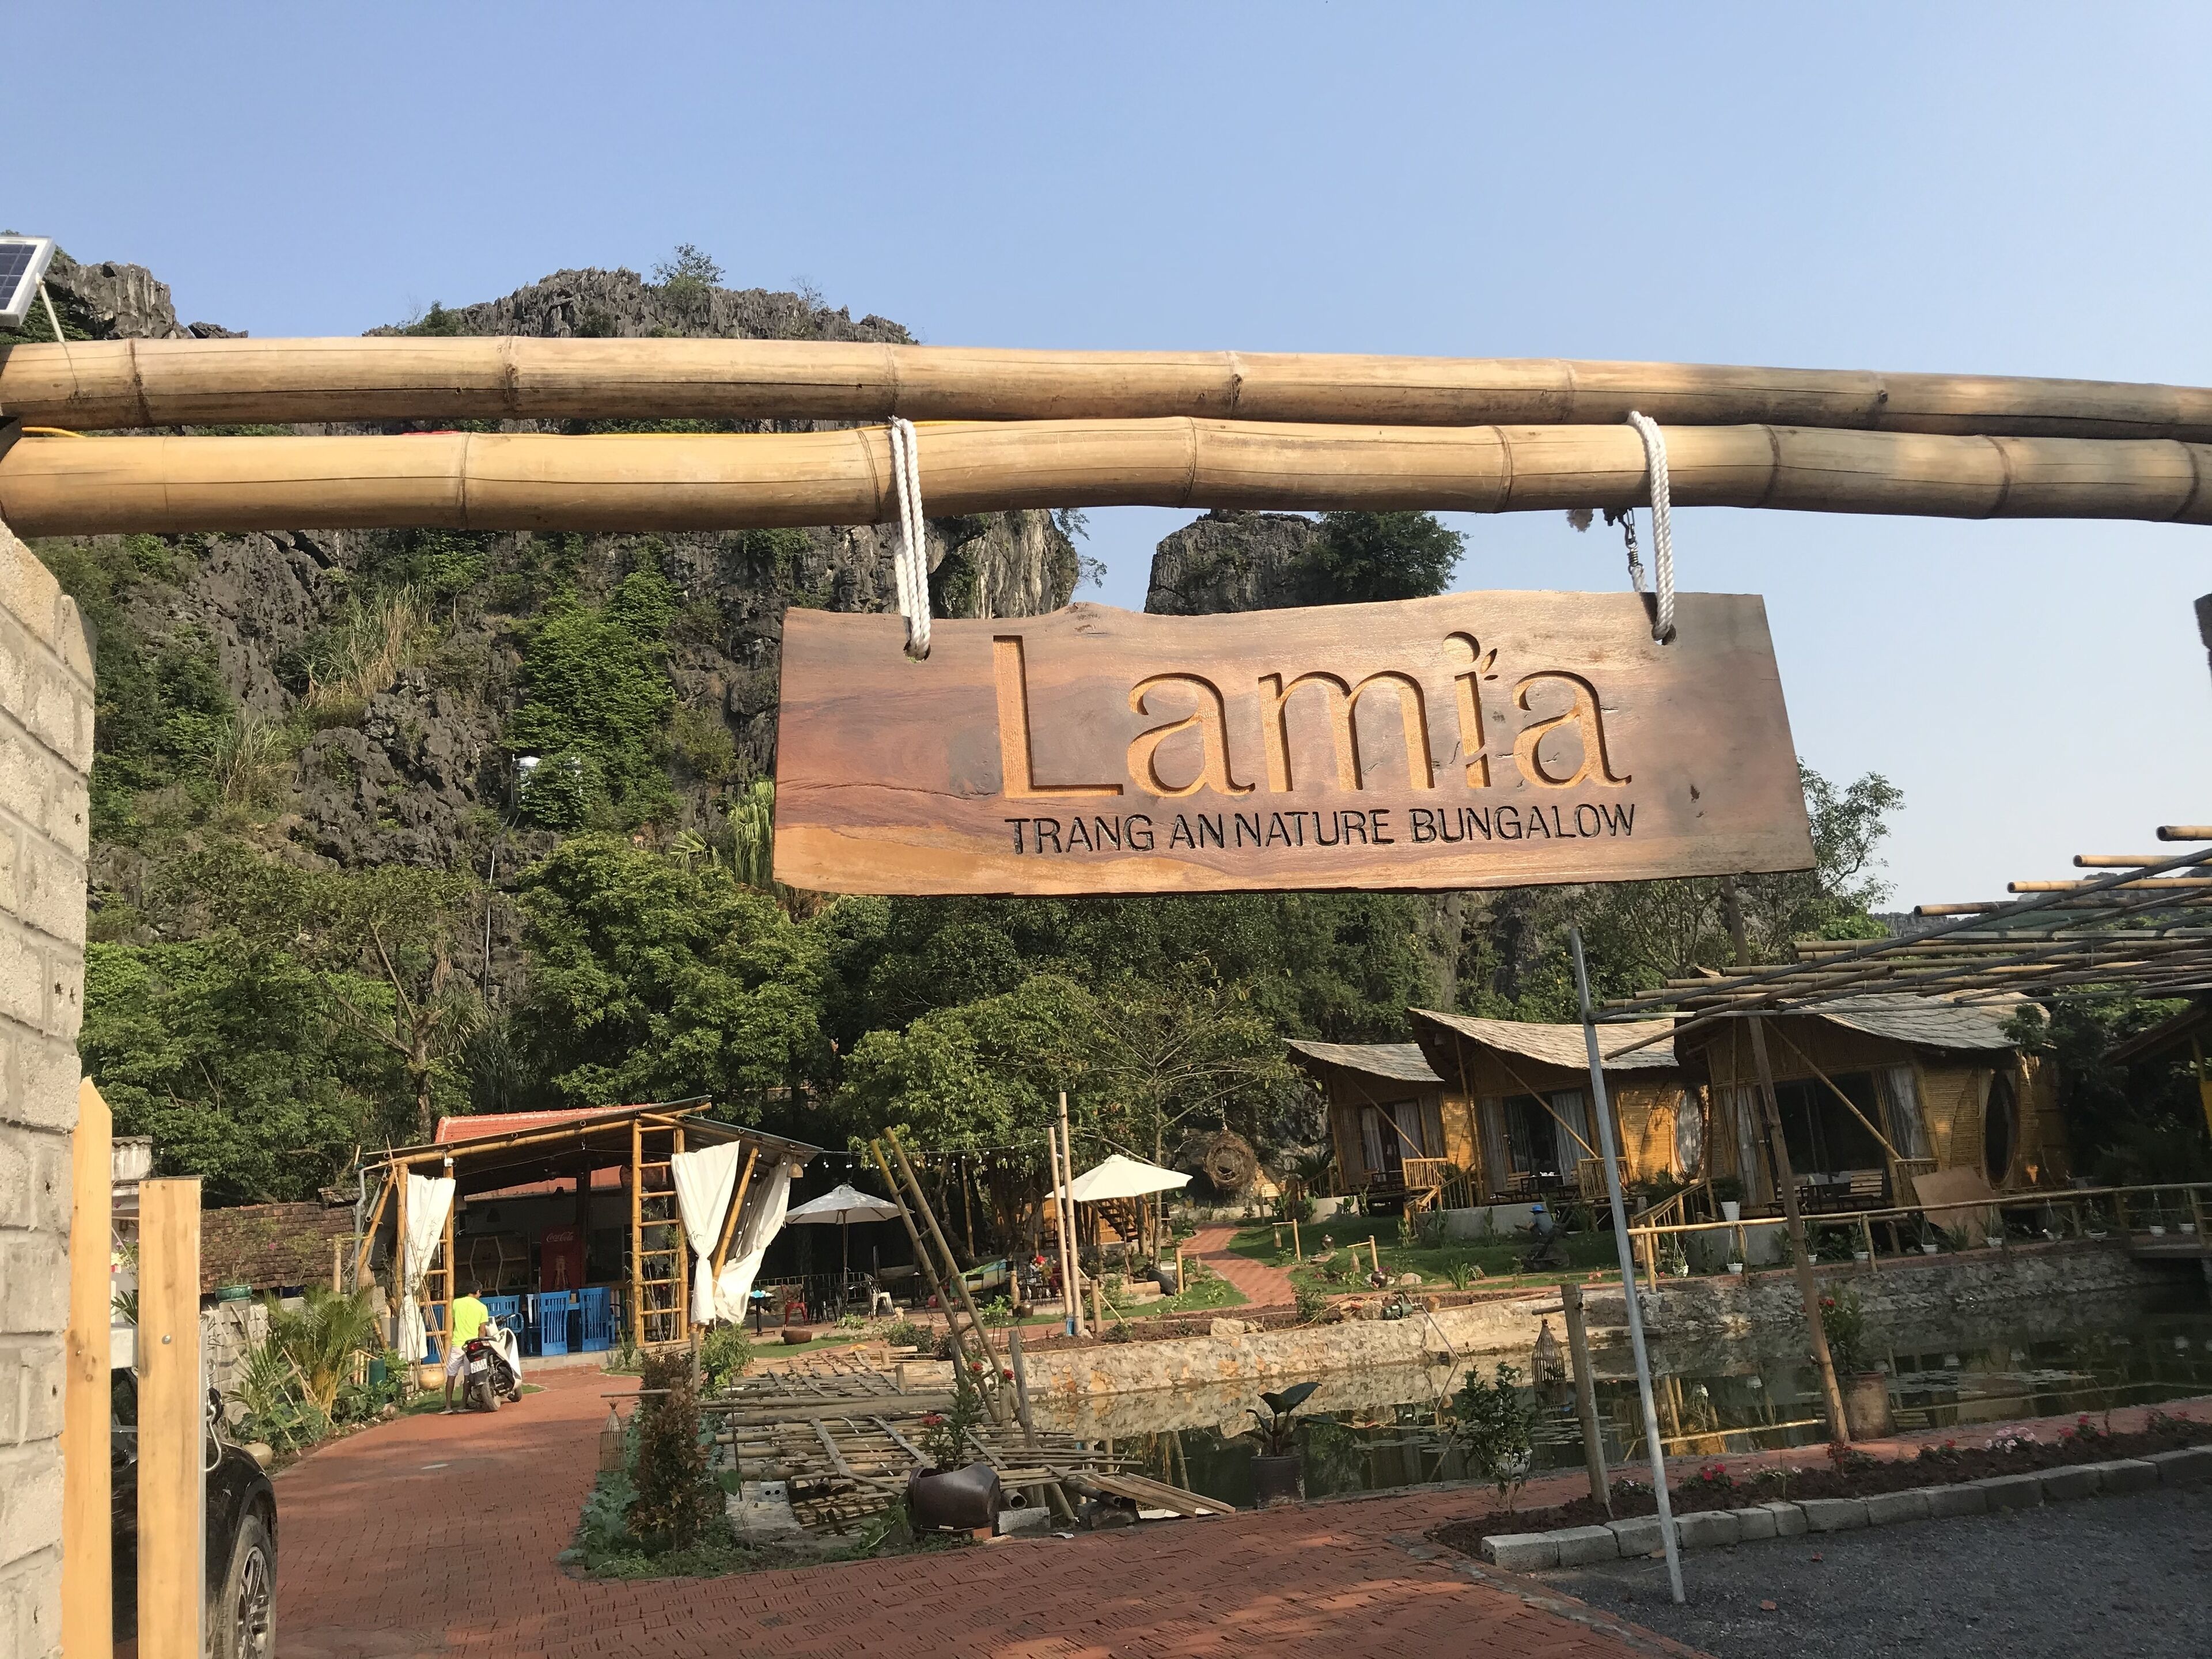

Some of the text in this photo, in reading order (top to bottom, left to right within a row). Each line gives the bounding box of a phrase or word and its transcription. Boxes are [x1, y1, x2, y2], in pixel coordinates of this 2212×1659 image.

[993, 631, 1631, 798] Lamia
[1005, 803, 1635, 854] TRANG AN NATURE BUNGALOW
